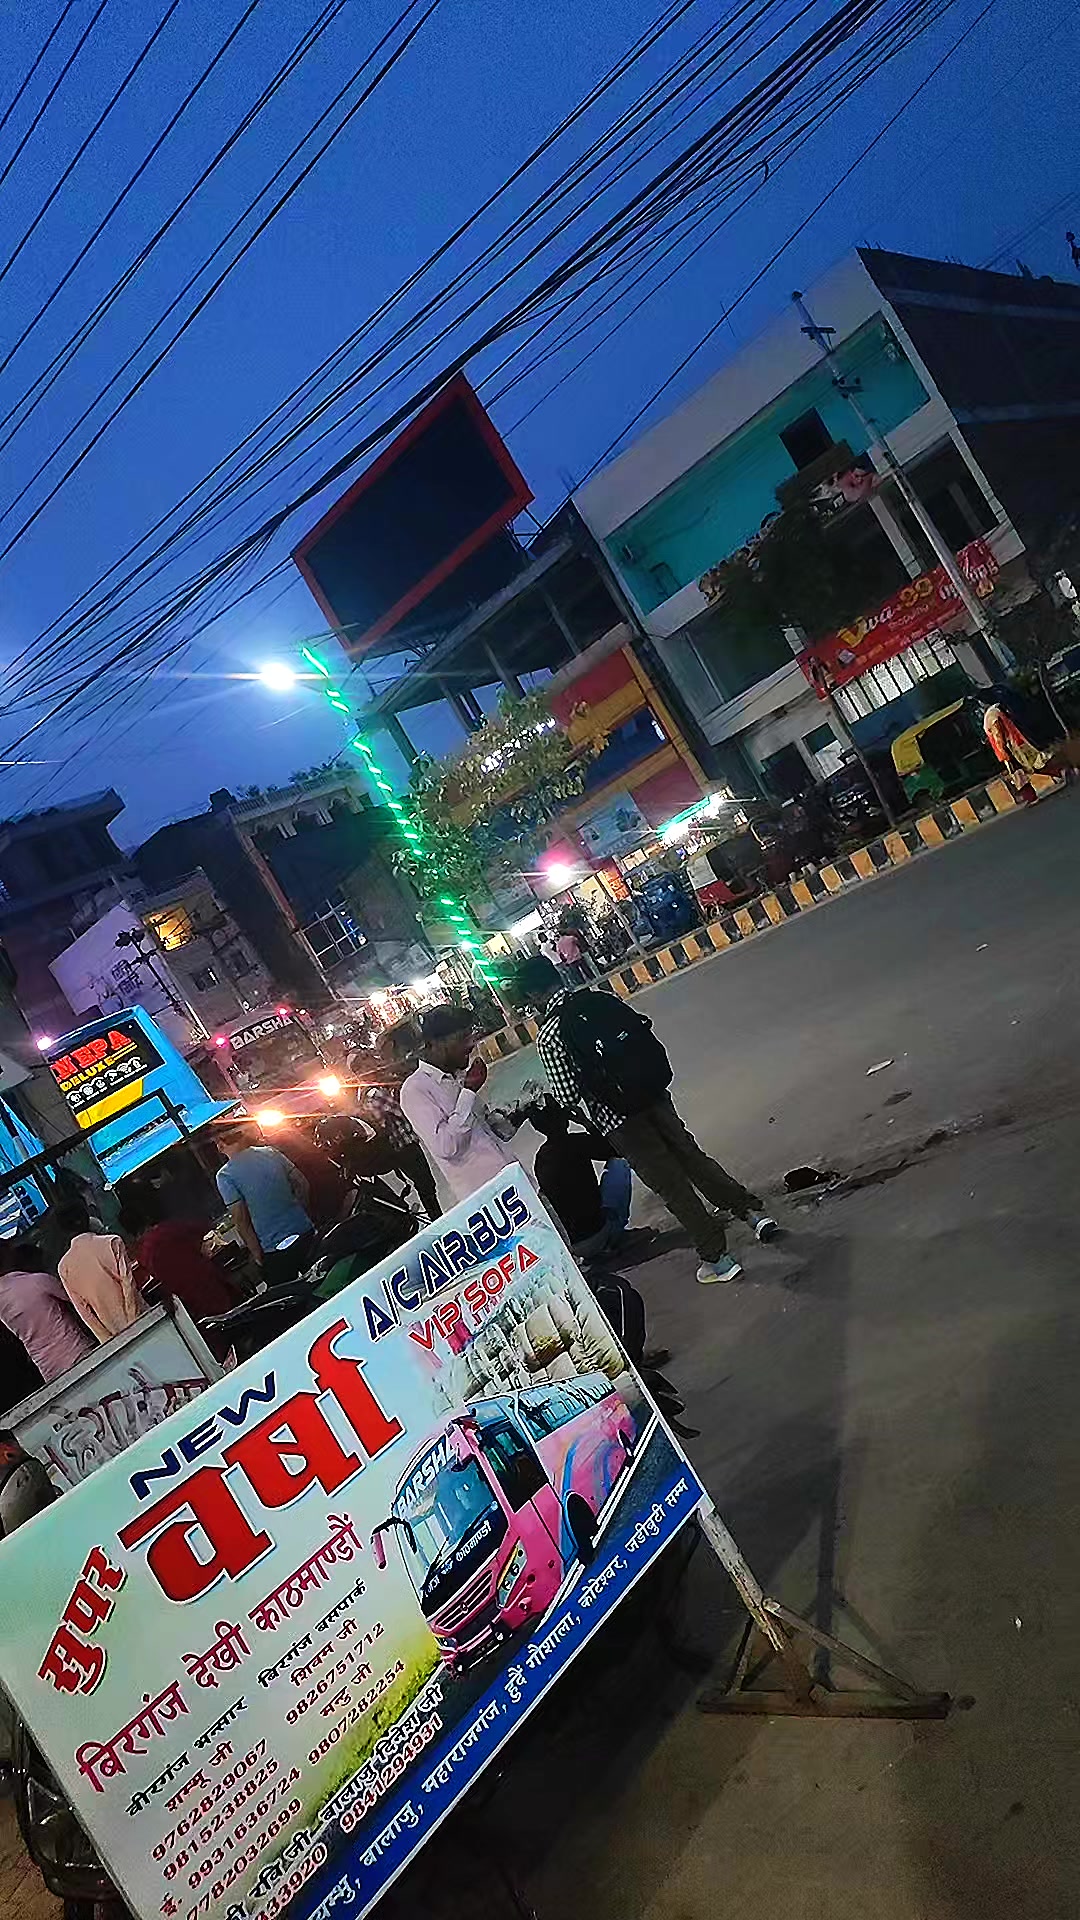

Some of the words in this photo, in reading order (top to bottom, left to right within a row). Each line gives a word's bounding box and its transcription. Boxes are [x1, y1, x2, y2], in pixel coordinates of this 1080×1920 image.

[60, 1057, 115, 1091] DELUXE
[230, 1016, 293, 1050] BARSHA
[361, 1265, 422, 1342] A/C
[419, 1229, 478, 1296] AIR
[467, 1185, 531, 1255] BUS
[409, 1300, 461, 1351] VIP
[463, 1244, 540, 1312] SOFA
[117, 1317, 406, 1604] वर्षा
[129, 1371, 276, 1500] NEW
[37, 1545, 128, 1695] सुपर
[76, 1680, 190, 1792] बिरगंज
[181, 1621, 251, 1688] देखी
[248, 1513, 362, 1631] काठमाण्डौं
[258, 1633, 313, 1687] बिरगंज
[315, 1578, 367, 1632] बसपार्क
[285, 1622, 385, 1725] 9826751712
[290, 1641, 334, 1686] शिवम
[336, 1618, 359, 1640] जी
[351, 1662, 373, 1685] जी
[125, 1751, 190, 1816] वीरगंज
[194, 1696, 247, 1749] भन्सार
[209, 1741, 234, 1767] जी
[307, 1873, 361, 1920] यम्भु,
[360, 1800, 424, 1866] बालाजु,
[422, 1700, 507, 1792] महाराजगंज,
[526, 1611, 581, 1669] गौशाला,
[578, 1555, 628, 1609] कोटेश्वर,
[625, 1503, 666, 1552] जडीबुटी
[664, 1477, 689, 1507] सम्म
[307, 1660, 405, 1765] 9807282254
[319, 1759, 378, 1822] बालाजु
[374, 1710, 420, 1763] दिनेश
[418, 1682, 443, 1713] जी
[152, 1738, 266, 1861] 9762829067
[163, 1757, 279, 1880] 9815238825
[188, 1767, 301, 1889] 9931636724
[340, 1712, 443, 1833] 9841294931
[248, 1858, 283, 1898] रवि
[282, 1828, 311, 1861] जी
